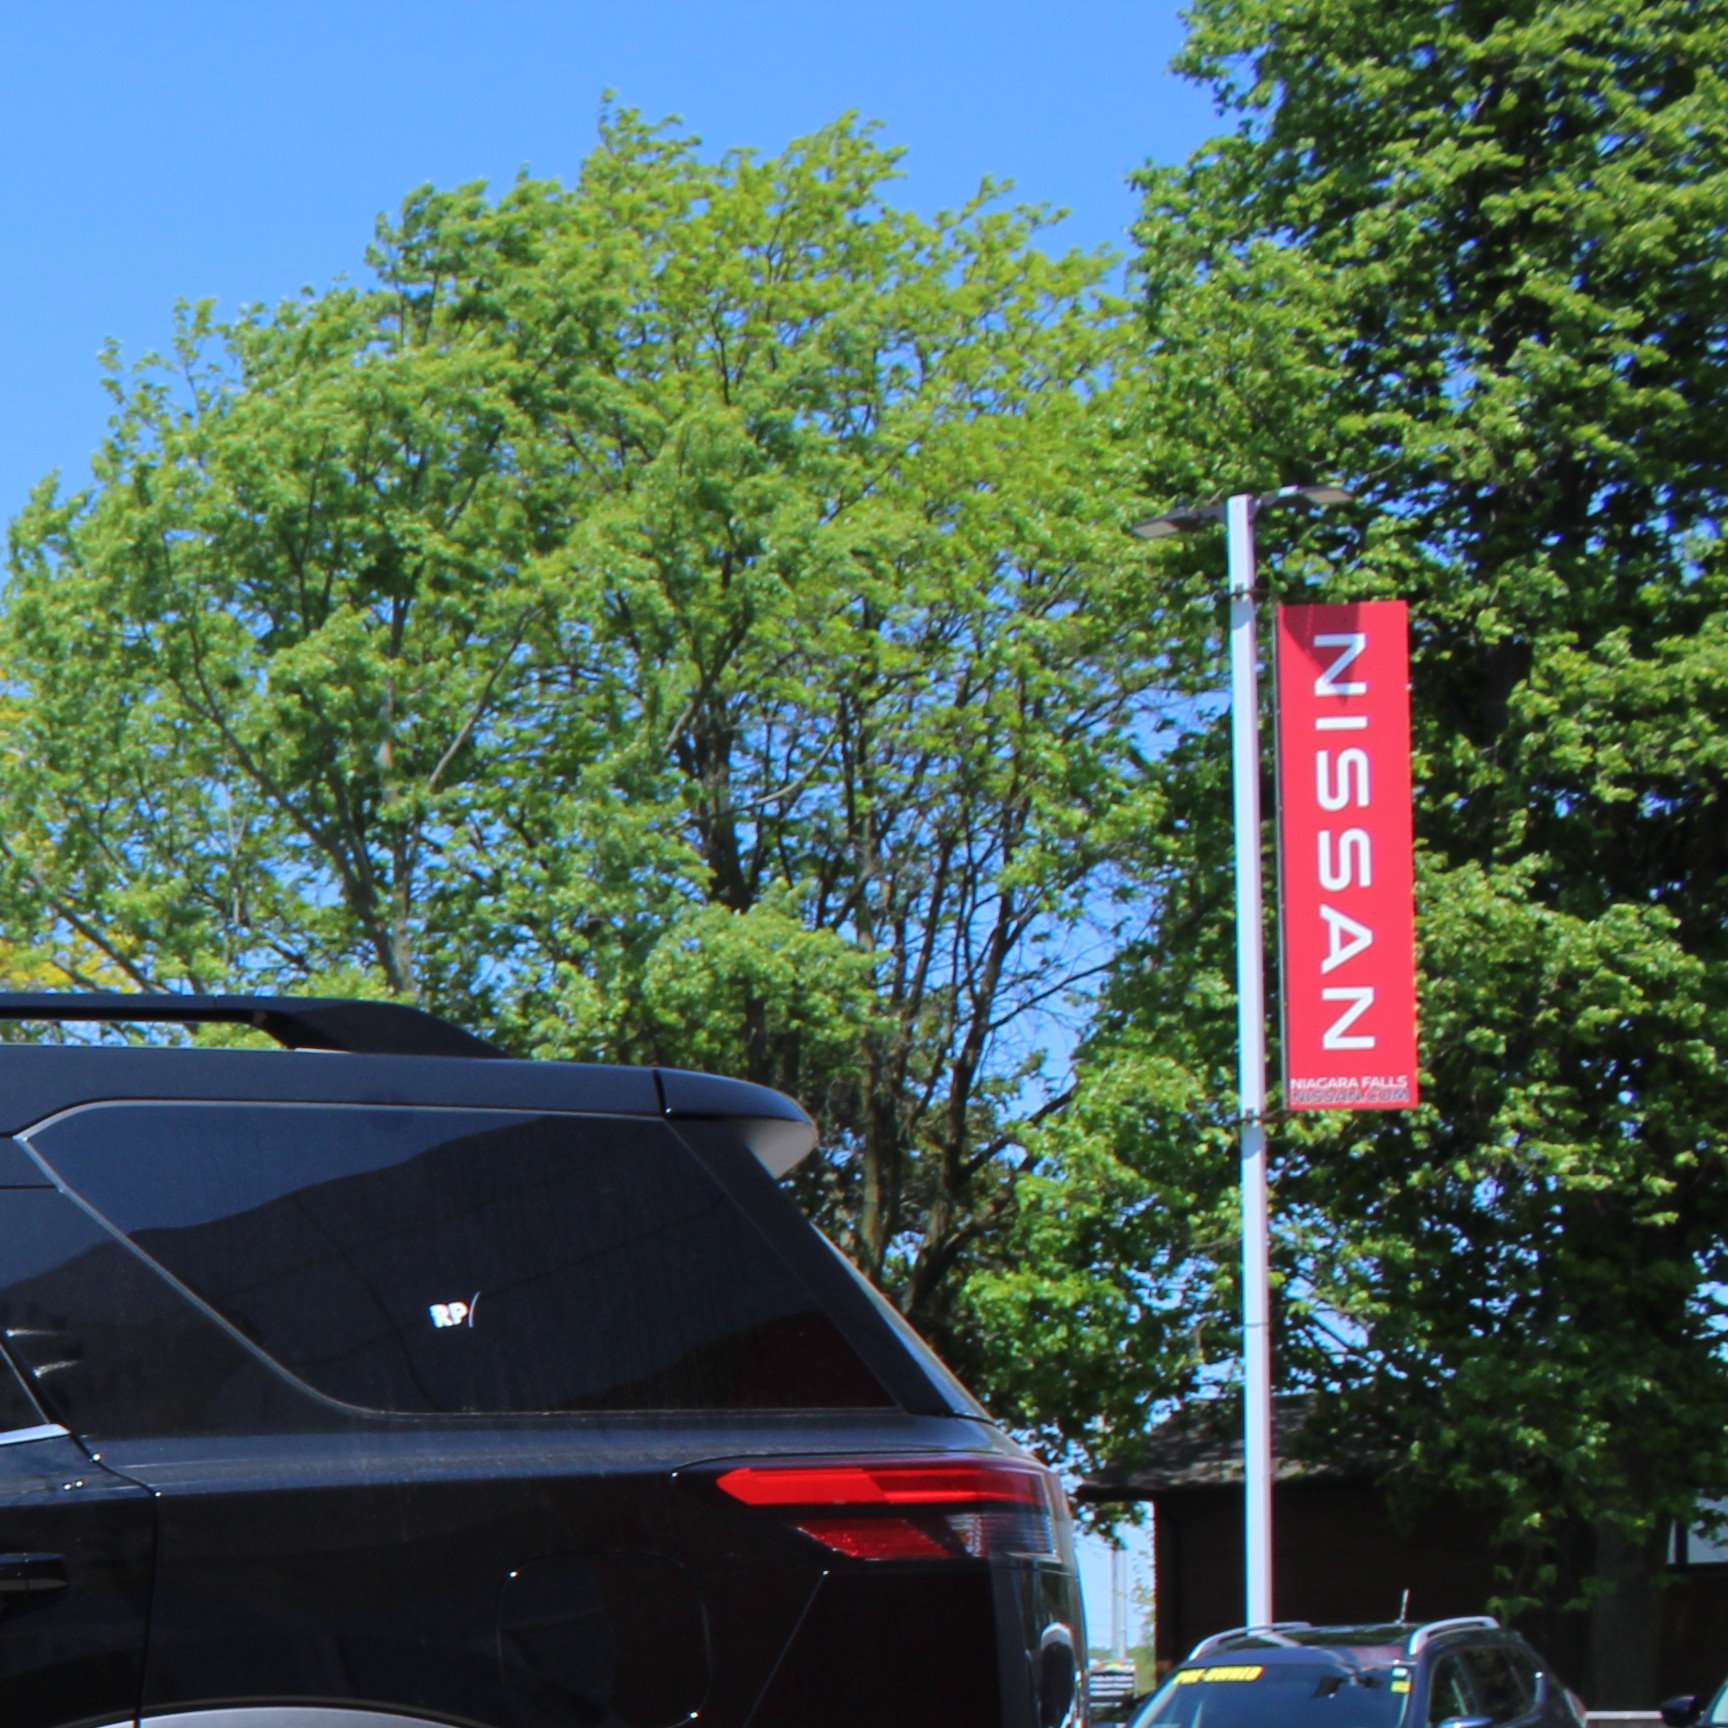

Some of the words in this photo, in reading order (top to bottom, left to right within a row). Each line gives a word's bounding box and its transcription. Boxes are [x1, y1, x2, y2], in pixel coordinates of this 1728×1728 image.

[1312, 632, 1377, 1051] NISSAN
[1290, 1077, 1359, 1089] NIAGARA
[1362, 1075, 1409, 1088] FALLS
